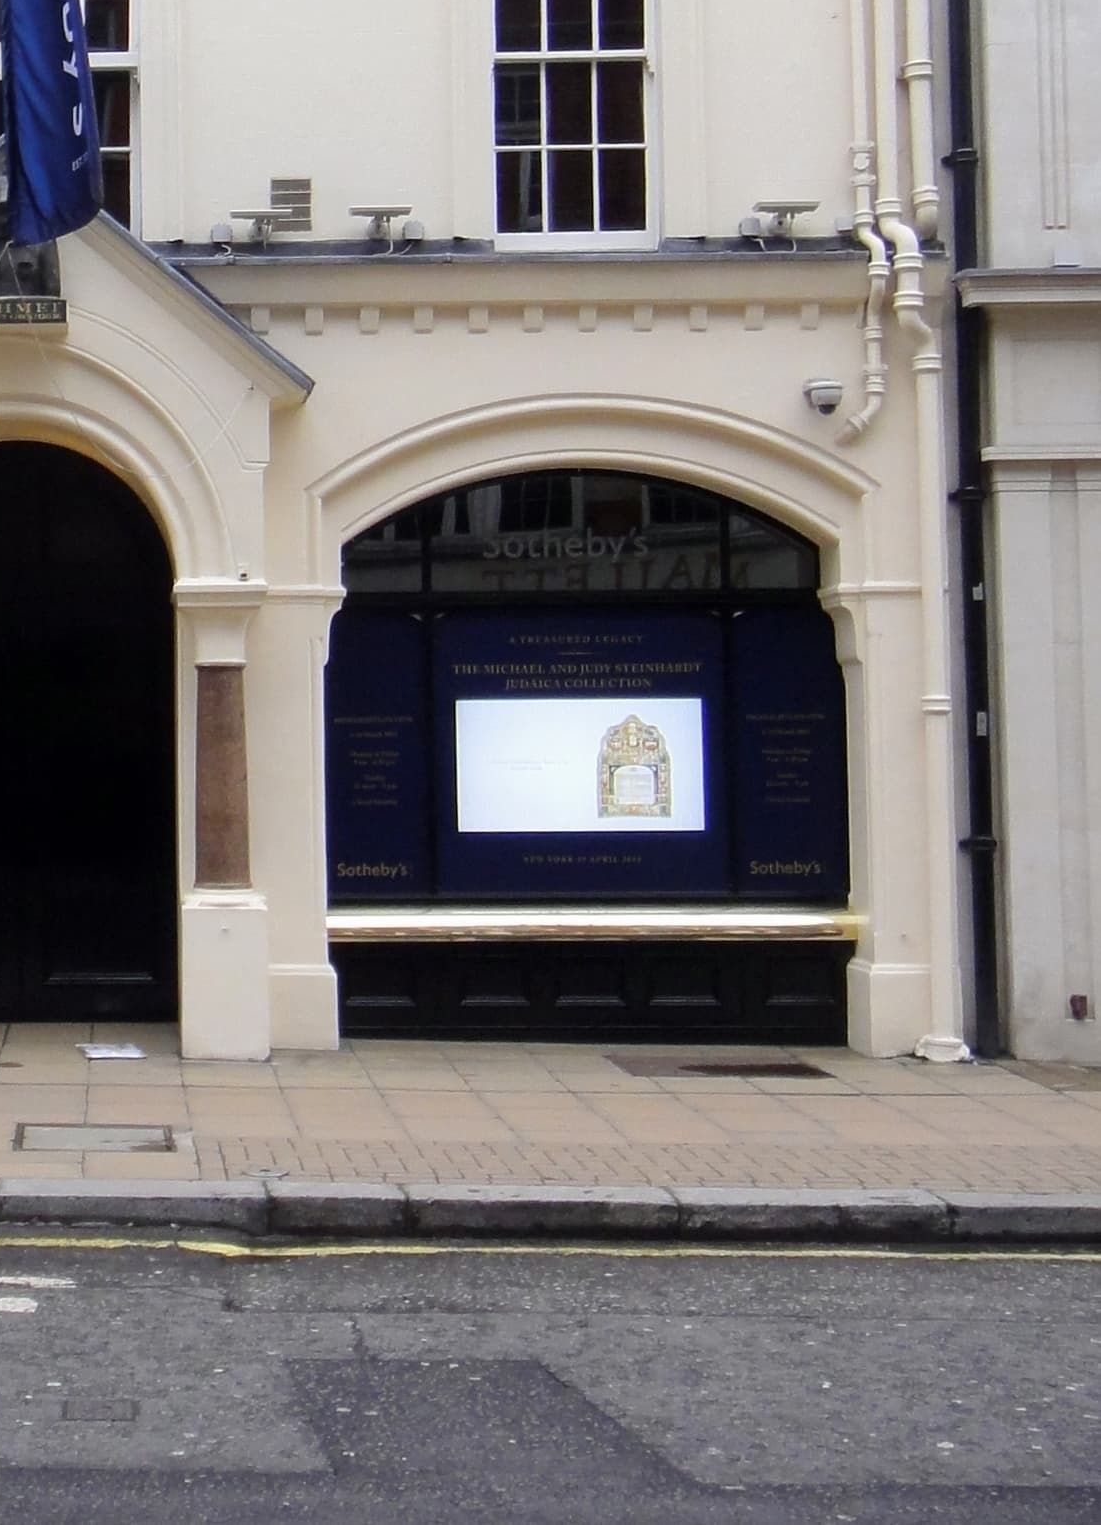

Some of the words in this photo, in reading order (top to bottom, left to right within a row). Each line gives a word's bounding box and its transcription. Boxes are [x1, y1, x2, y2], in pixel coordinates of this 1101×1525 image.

[482, 527, 649, 563] Sotheby's
[452, 664, 478, 674] THE
[482, 664, 545, 674] MICHAEL
[549, 664, 578, 674] AND
[579, 663, 611, 675] JUDY
[505, 678, 562, 690] JUDAICA
[564, 678, 652, 689] COLLECTION
[337, 862, 408, 879] Sotheby's
[750, 860, 821, 877] Sotheby's
